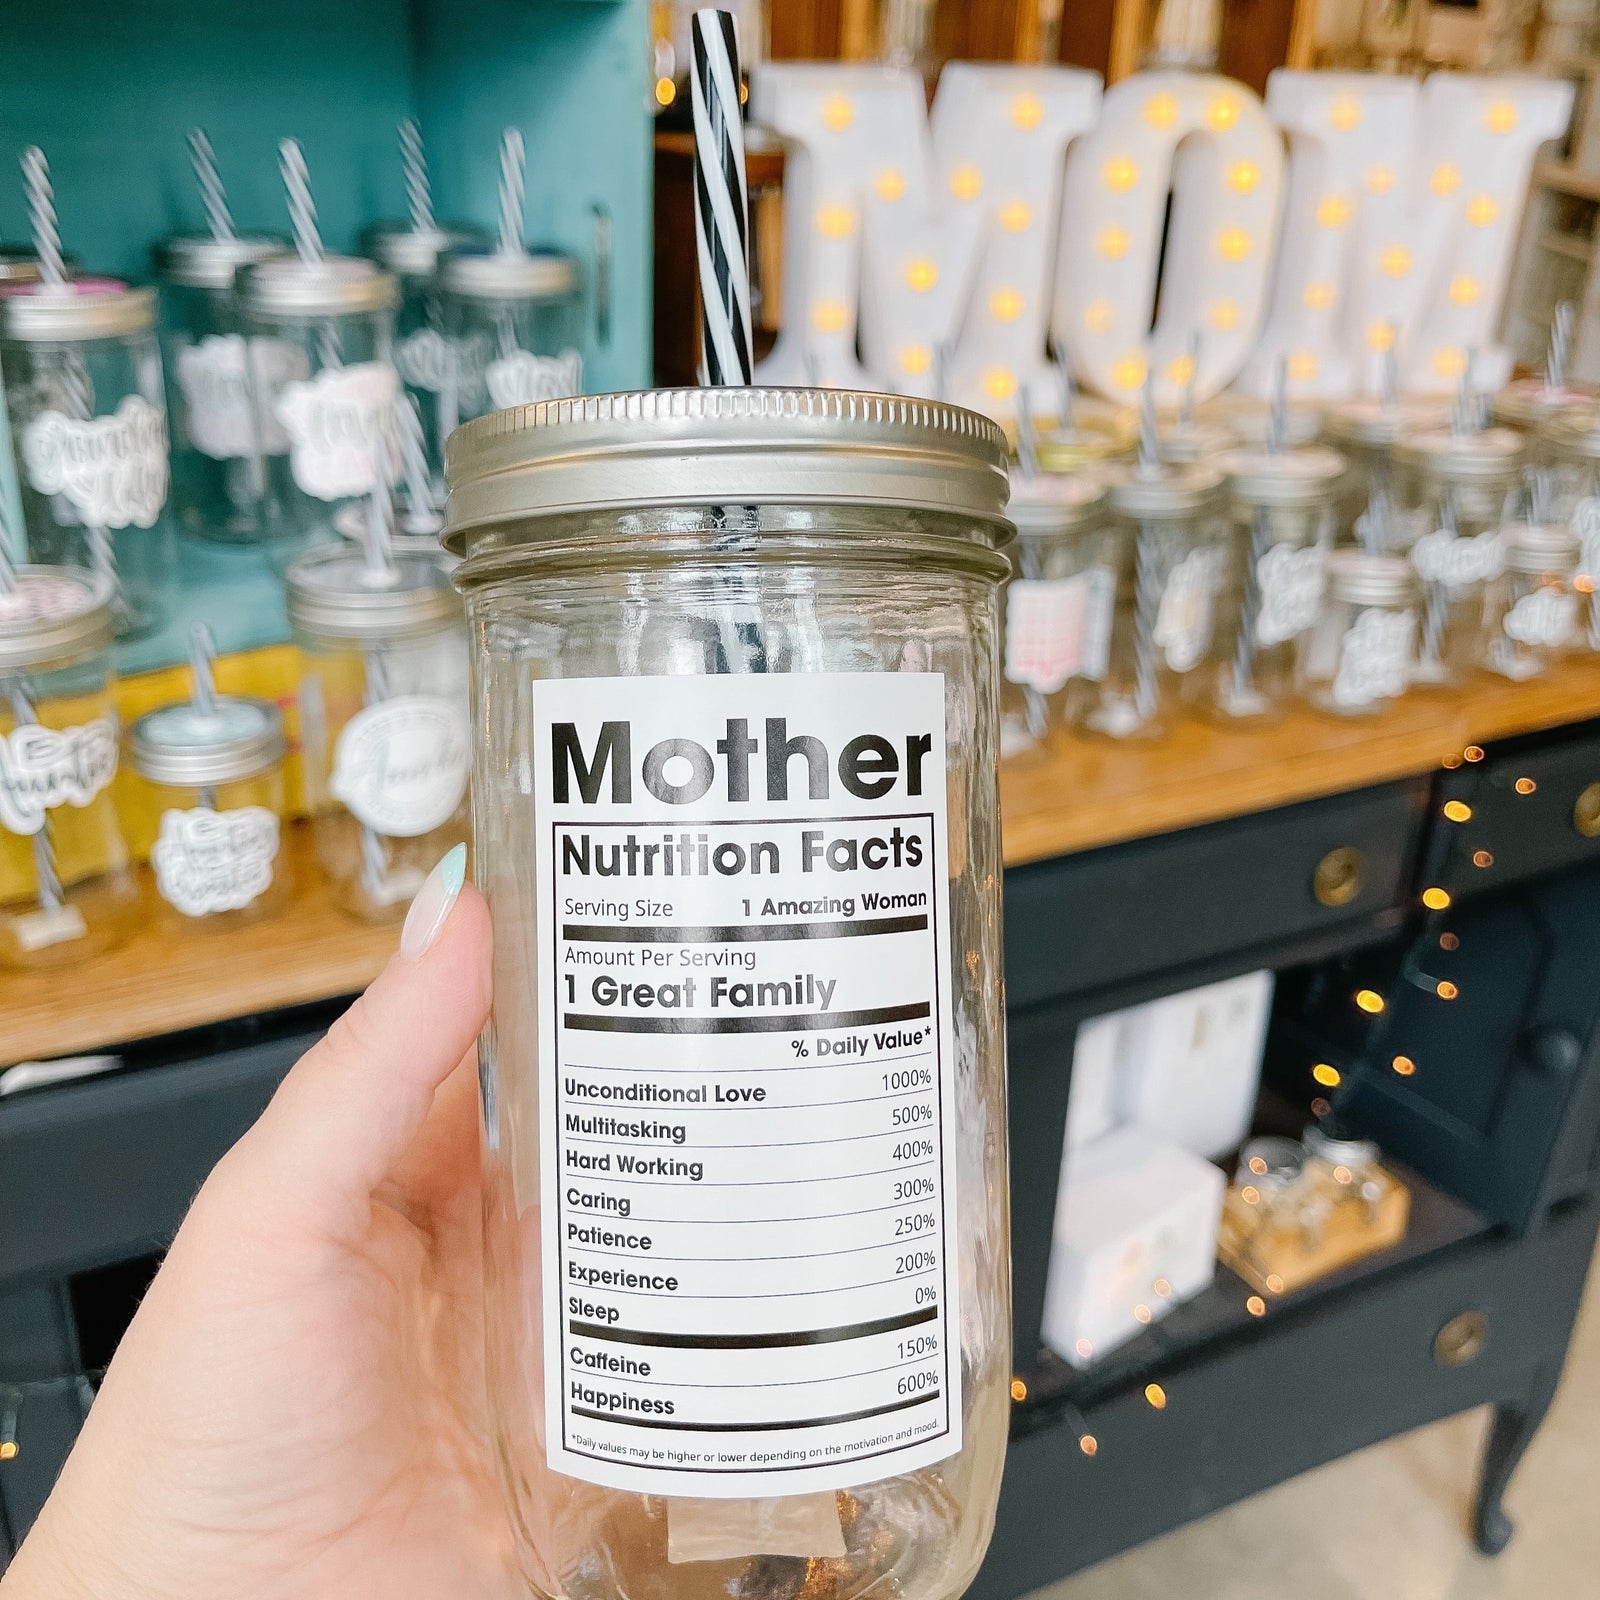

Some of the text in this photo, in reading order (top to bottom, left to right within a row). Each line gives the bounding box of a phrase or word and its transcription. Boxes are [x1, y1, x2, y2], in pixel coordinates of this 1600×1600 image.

[751, 60, 1577, 405] MOM
[551, 717, 932, 805] Mother
[562, 827, 922, 876] Nutrition Facts
[565, 891, 927, 921] Serving Size 1 Amazing Woman
[565, 947, 757, 970] Amount Per Serving
[565, 974, 837, 1010] 1 Great Family
[791, 1041, 809, 1057] %
[816, 1036, 869, 1058] Daily
[565, 1069, 932, 1103] Unconditional Love 1000%
[566, 1106, 932, 1145] Multitasking 500%
[566, 1140, 933, 1181] Hard Working 400%
[567, 1177, 934, 1216] Caring 300%
[568, 1213, 935, 1251] Patience 250%
[569, 1250, 936, 1292] Experience 200%
[569, 1286, 937, 1323] Sleep 0%
[570, 1335, 938, 1376] Caffeine 150%
[571, 1370, 939, 1414] Happiness 600%
[598, 1441, 627, 1454] values
[629, 1448, 650, 1460] may
[652, 1449, 665, 1459] be
[667, 1450, 700, 1463] higher
[703, 1453, 715, 1462] or
[718, 1452, 746, 1462] lower
[749, 1450, 806, 1464] depending
[809, 1449, 822, 1457] on
[825, 1445, 841, 1455] the
[844, 1433, 894, 1452] motivation
[895, 1427, 912, 1440] and
[914, 1418, 939, 1436] mood.
